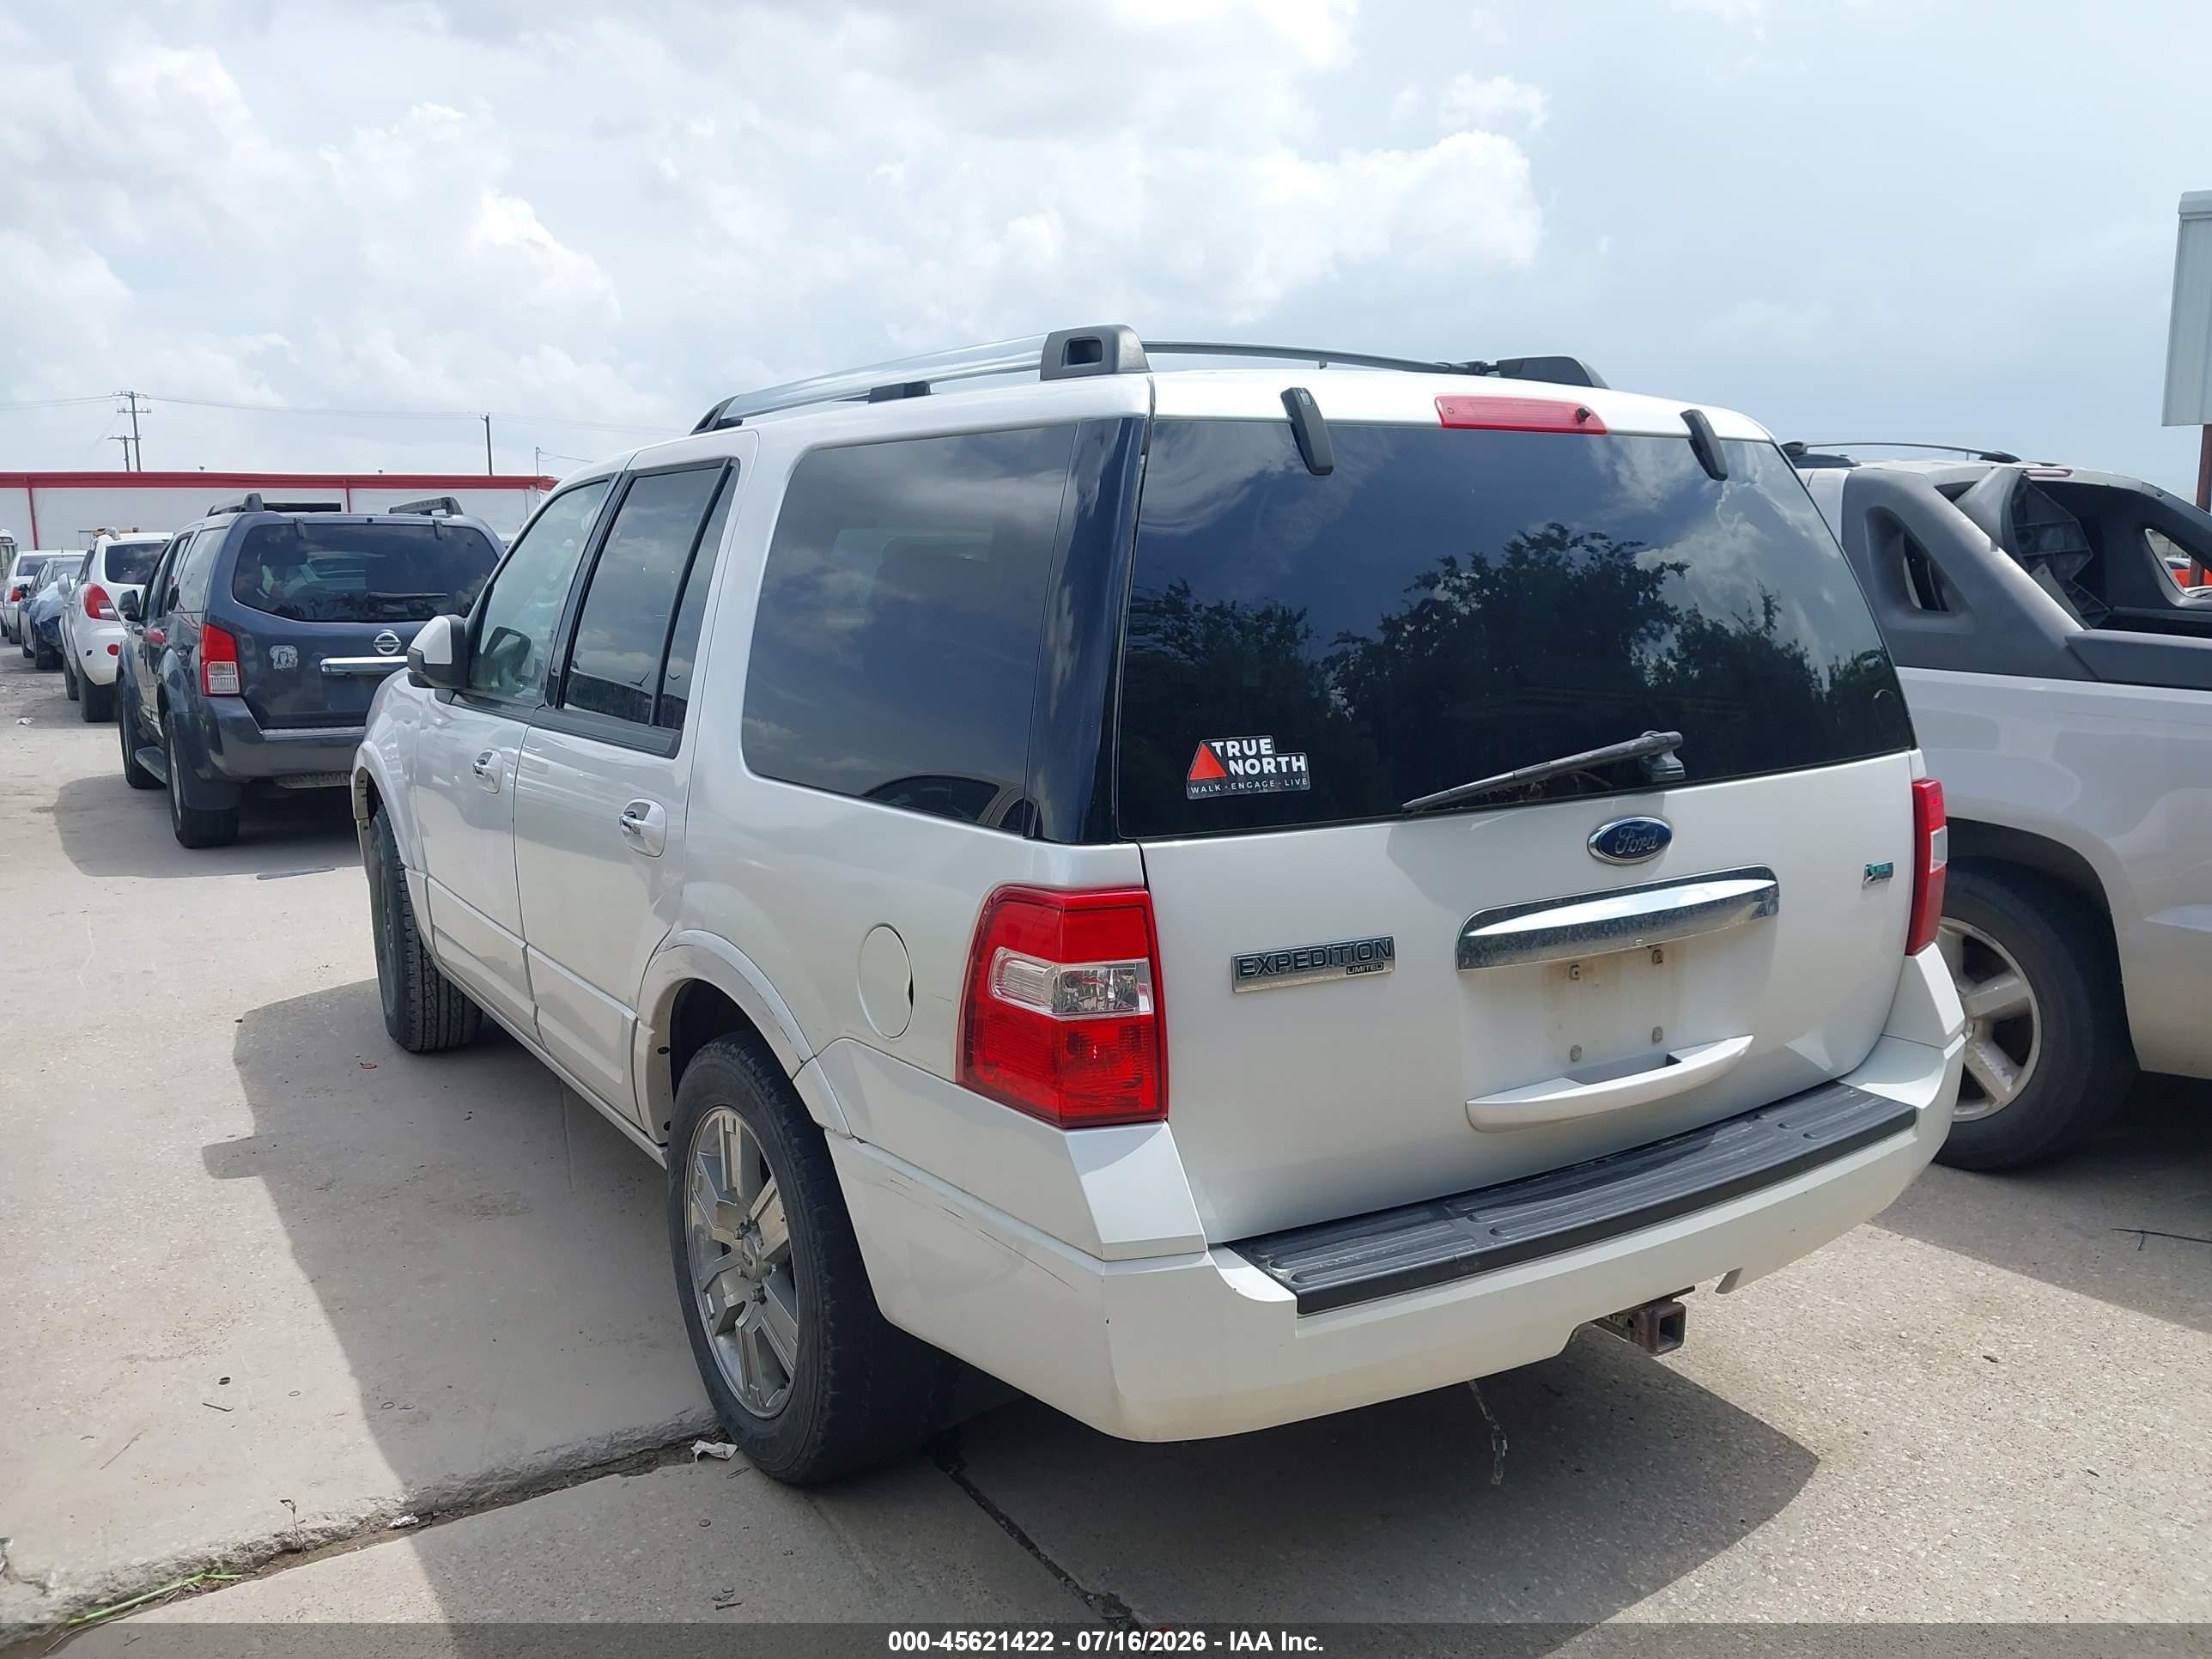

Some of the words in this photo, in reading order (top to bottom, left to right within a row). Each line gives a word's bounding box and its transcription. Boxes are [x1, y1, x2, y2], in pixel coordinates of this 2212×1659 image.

[1211, 738, 1273, 757] TRUE
[1228, 756, 1306, 776] NORTH
[1190, 784, 1222, 794] WALK
[1231, 780, 1275, 790] ENGAGE
[1285, 777, 1308, 787] LIVE
[1614, 824, 1659, 854] Ford
[1237, 939, 1393, 977] EXPEDITION
[1346, 963, 1383, 975] LIMITED
